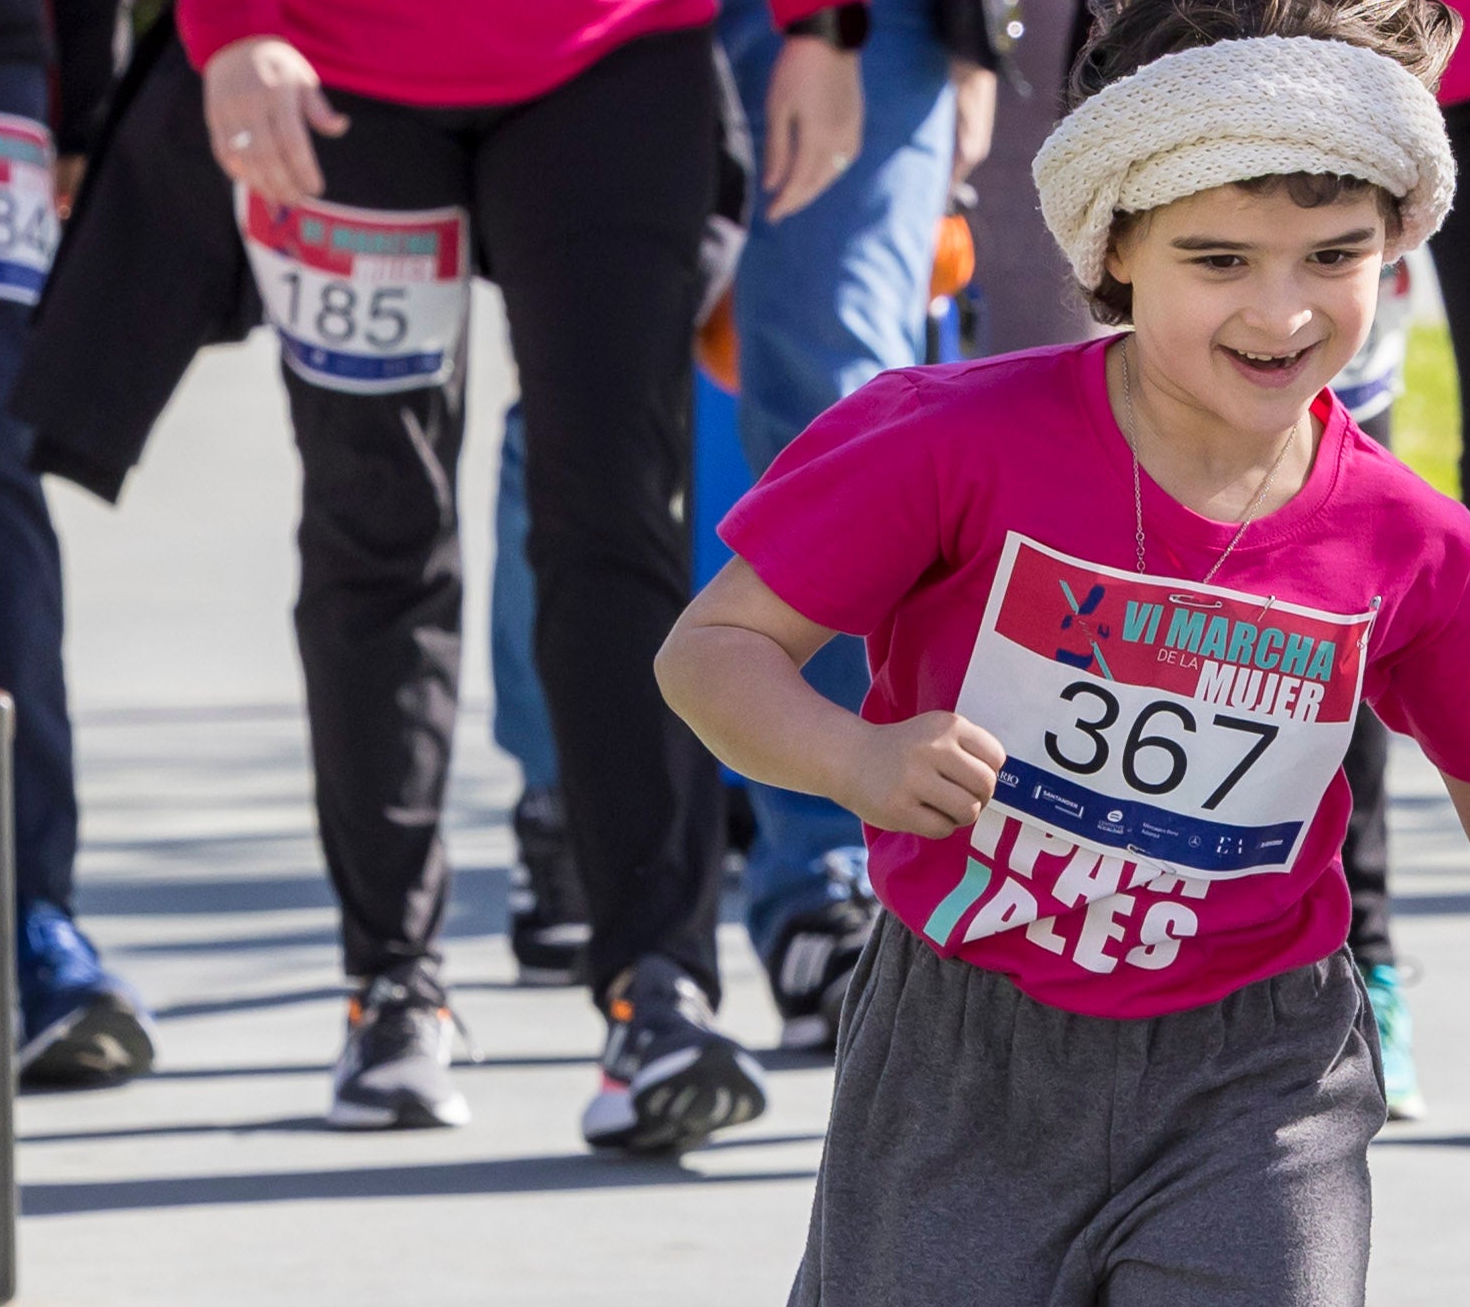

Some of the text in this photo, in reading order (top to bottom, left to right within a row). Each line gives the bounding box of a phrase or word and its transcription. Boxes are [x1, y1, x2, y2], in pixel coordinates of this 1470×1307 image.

[280, 270, 410, 349] 185
[1122, 601, 1337, 682] VI MARCHA
[1157, 647, 1326, 723] DE LA MUJER
[1044, 681, 1279, 810] 367
